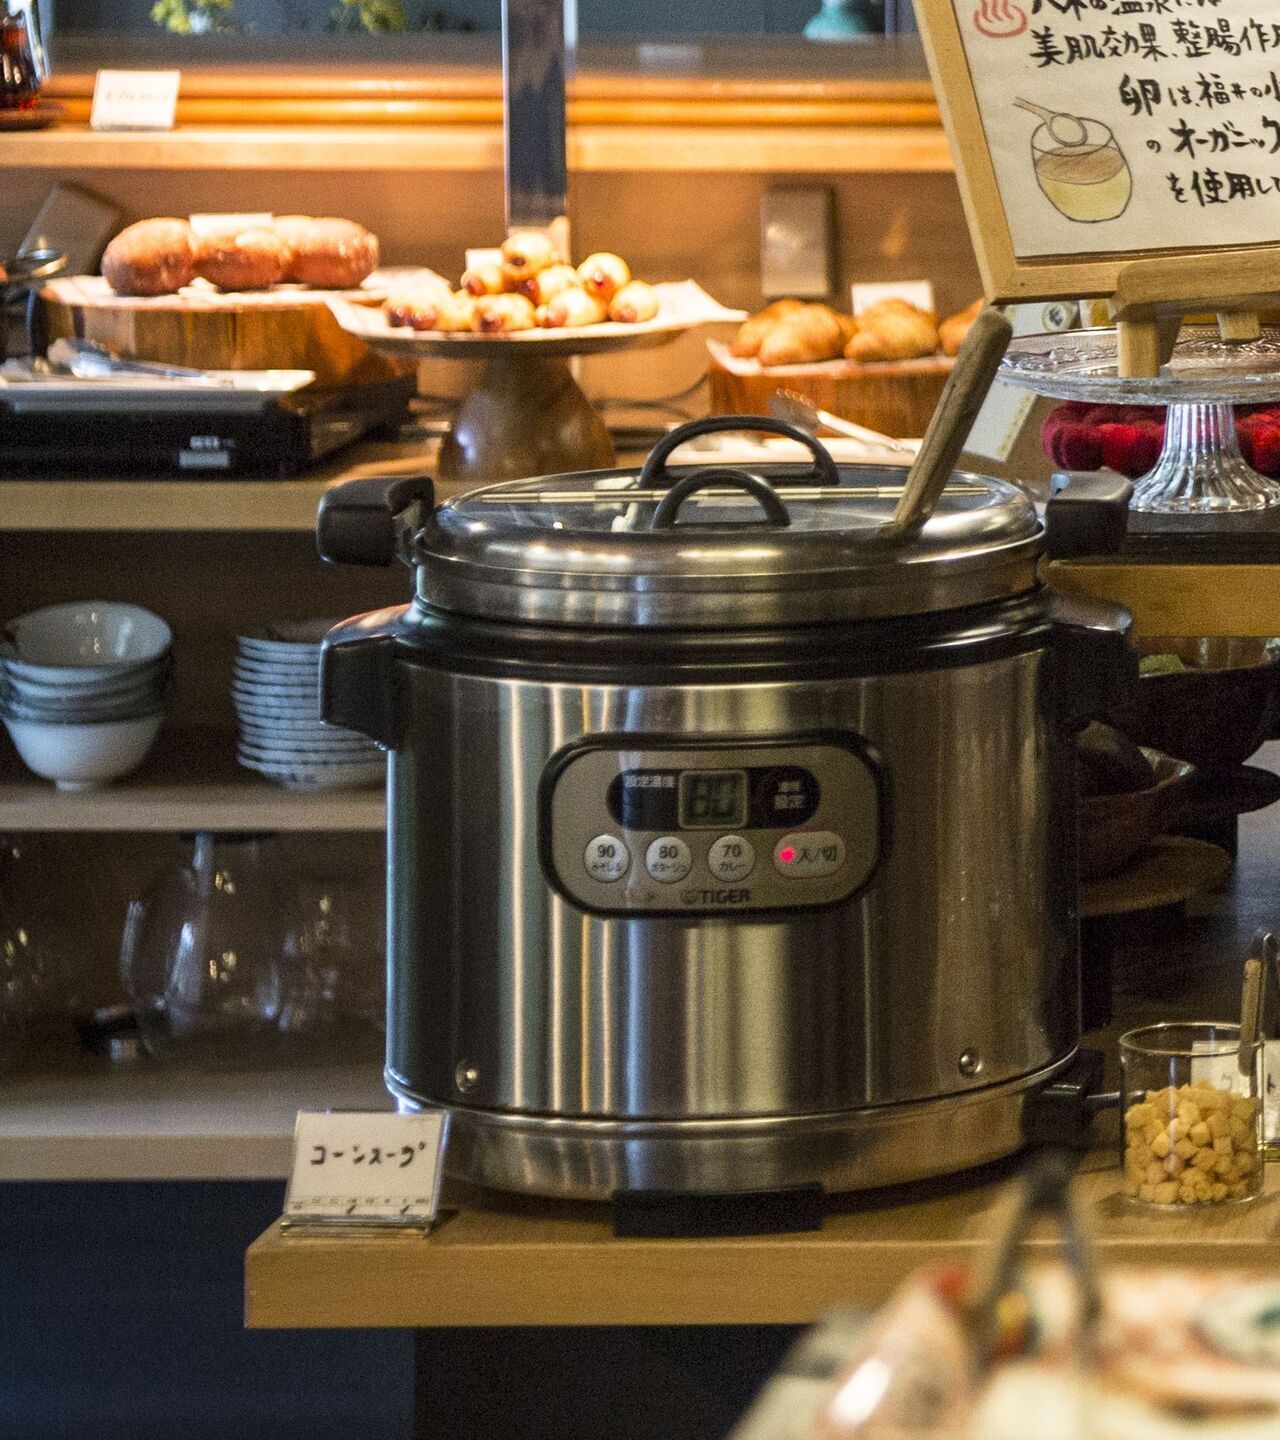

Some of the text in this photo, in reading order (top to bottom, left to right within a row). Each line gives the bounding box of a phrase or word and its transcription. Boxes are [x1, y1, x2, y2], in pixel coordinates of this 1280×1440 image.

[597, 844, 616, 858] 90
[659, 845, 679, 859] 80
[721, 844, 742, 858] 70
[718, 862, 745, 873] カレー
[700, 889, 751, 904] TIGER
[310, 1141, 427, 1168] コーンスープ
